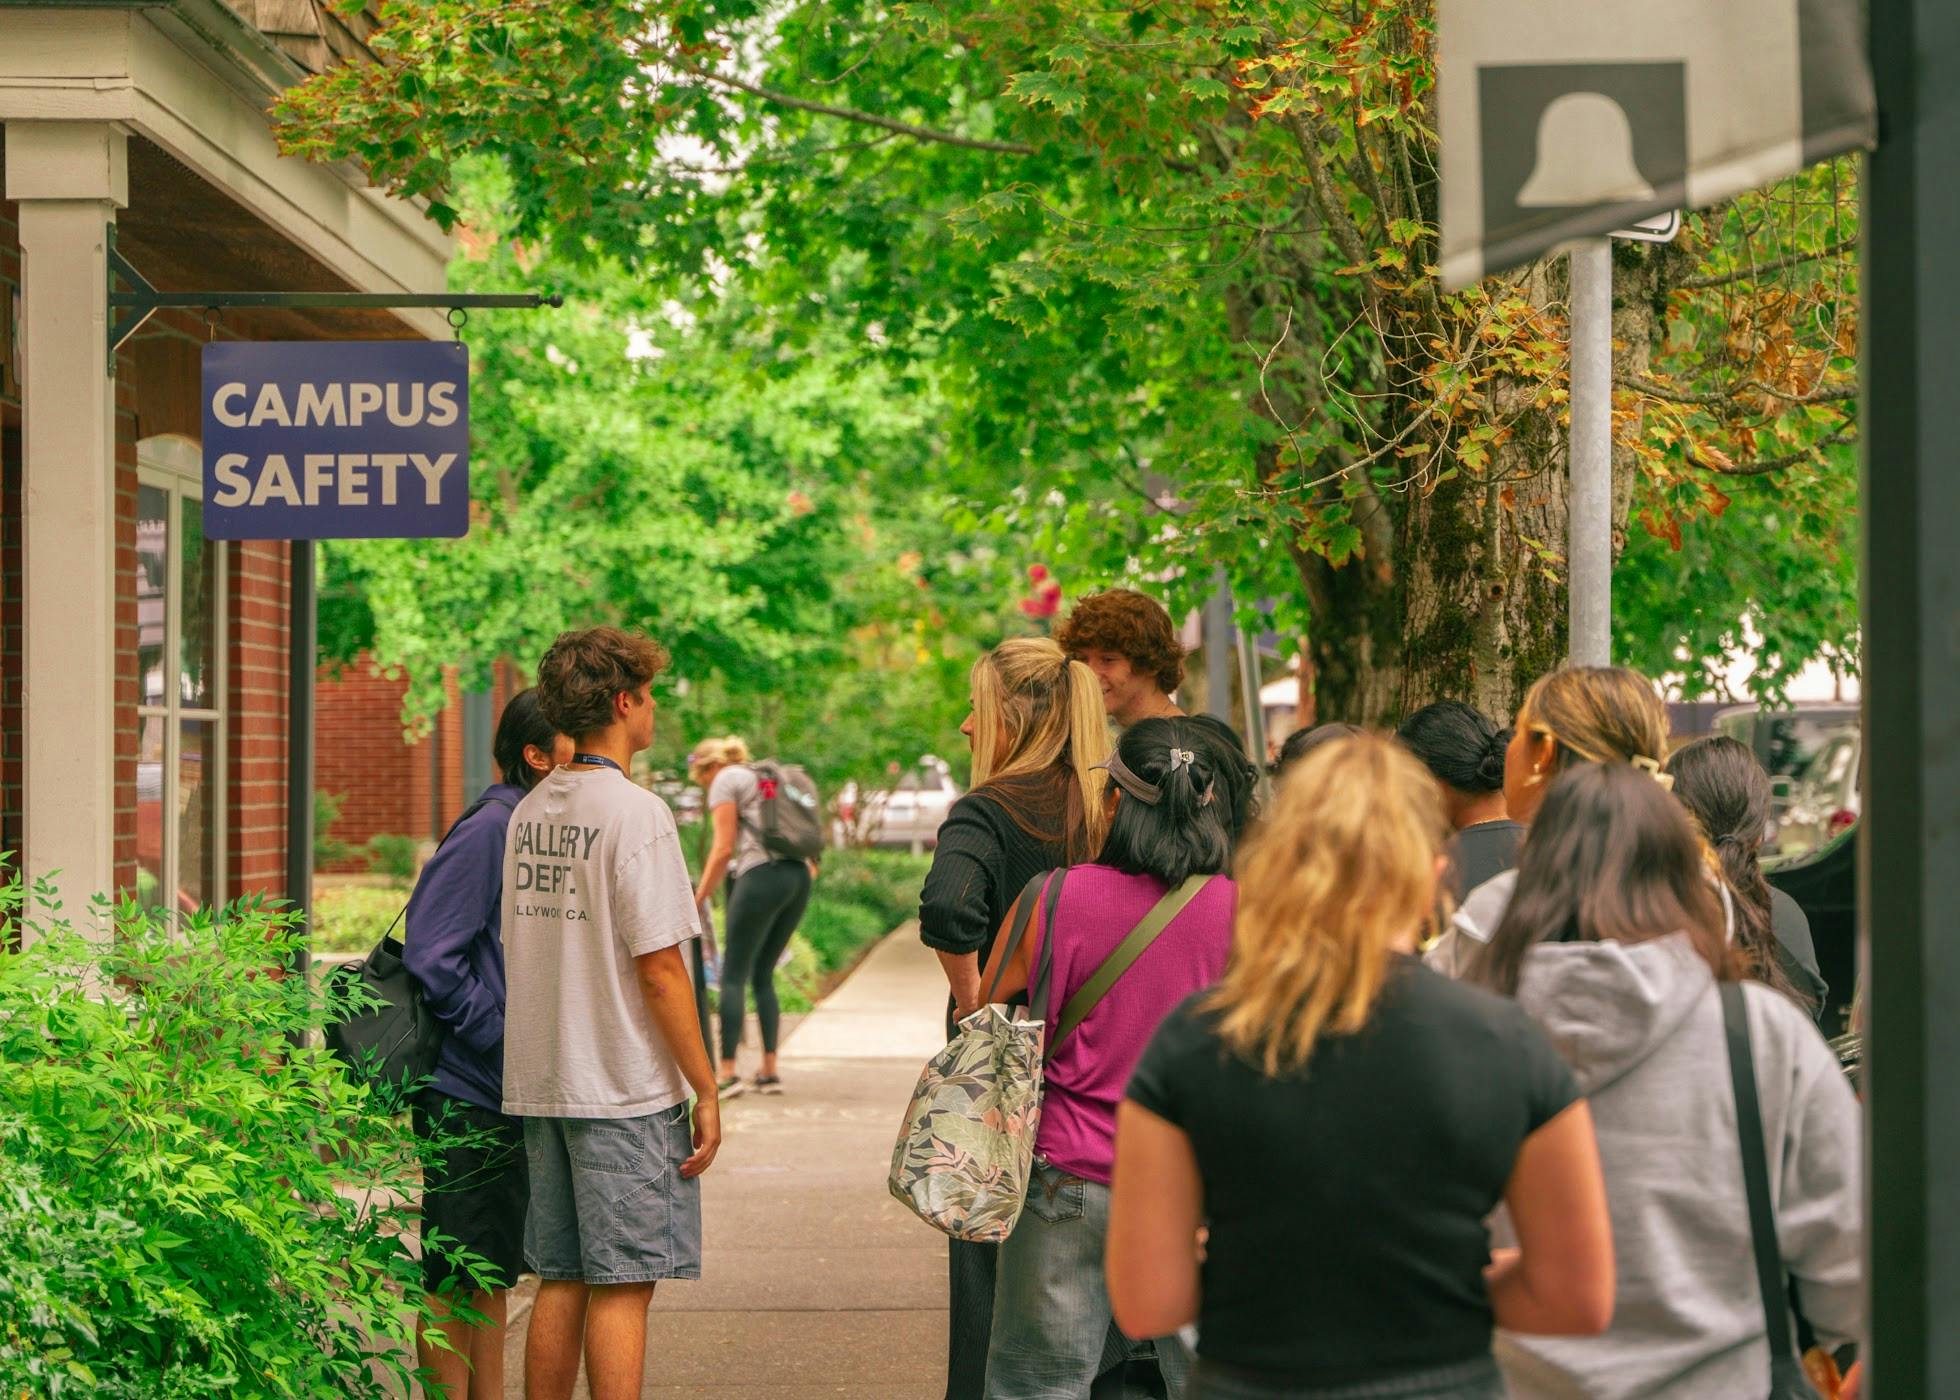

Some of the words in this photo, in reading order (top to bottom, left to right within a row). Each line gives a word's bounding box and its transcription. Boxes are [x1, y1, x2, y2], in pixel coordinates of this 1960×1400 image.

[212, 382, 459, 427] CAMPUS
[213, 453, 458, 507] SAFETY
[515, 821, 600, 860] GALLERY
[515, 862, 576, 894] DEPT.
